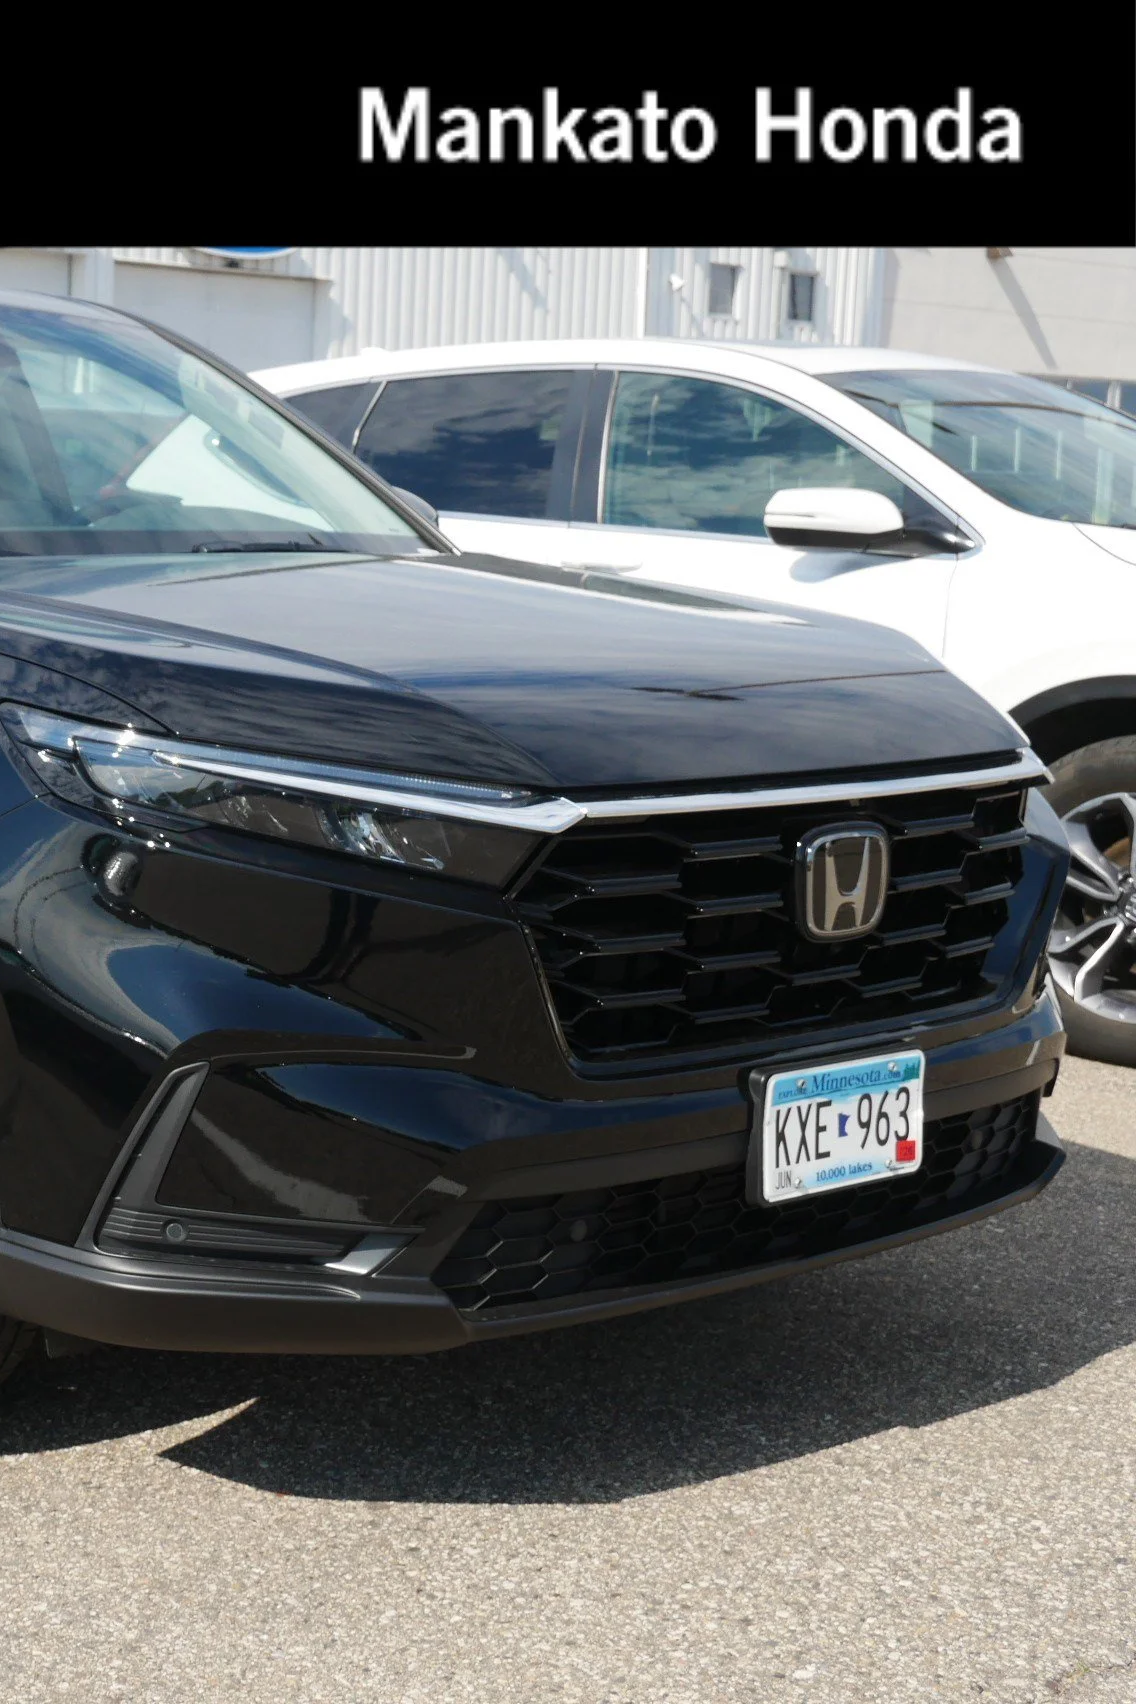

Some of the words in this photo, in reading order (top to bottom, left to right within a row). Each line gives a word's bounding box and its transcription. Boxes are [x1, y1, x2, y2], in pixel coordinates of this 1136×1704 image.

[775, 1099, 833, 1169] KXE
[857, 1087, 910, 1150] 963
[775, 1170, 792, 1190] JUN
[816, 1166, 846, 1182] 10,000
[848, 1162, 872, 1175] lakes
